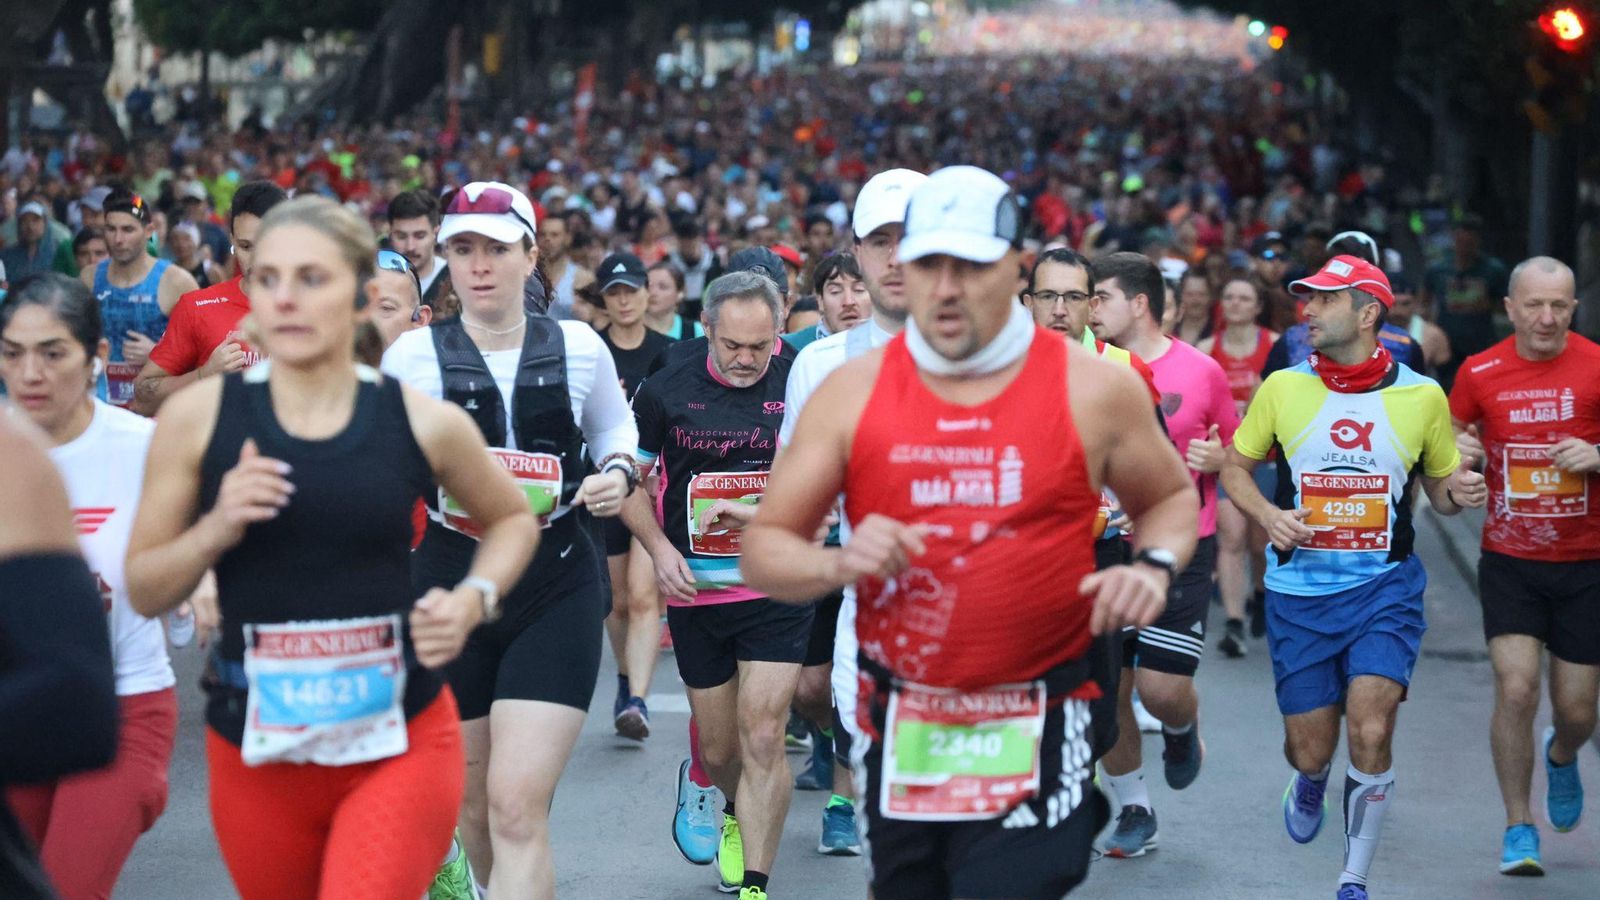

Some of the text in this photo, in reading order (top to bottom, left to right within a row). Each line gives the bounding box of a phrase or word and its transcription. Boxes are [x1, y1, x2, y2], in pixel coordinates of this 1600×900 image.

[1510, 408, 1558, 423] MÁLAGA
[1321, 453, 1377, 467] JEALSA
[1531, 471, 1560, 484] 614
[1322, 502, 1366, 516] 4298
[282, 674, 369, 706] 14621
[928, 730, 1003, 757] 2340
